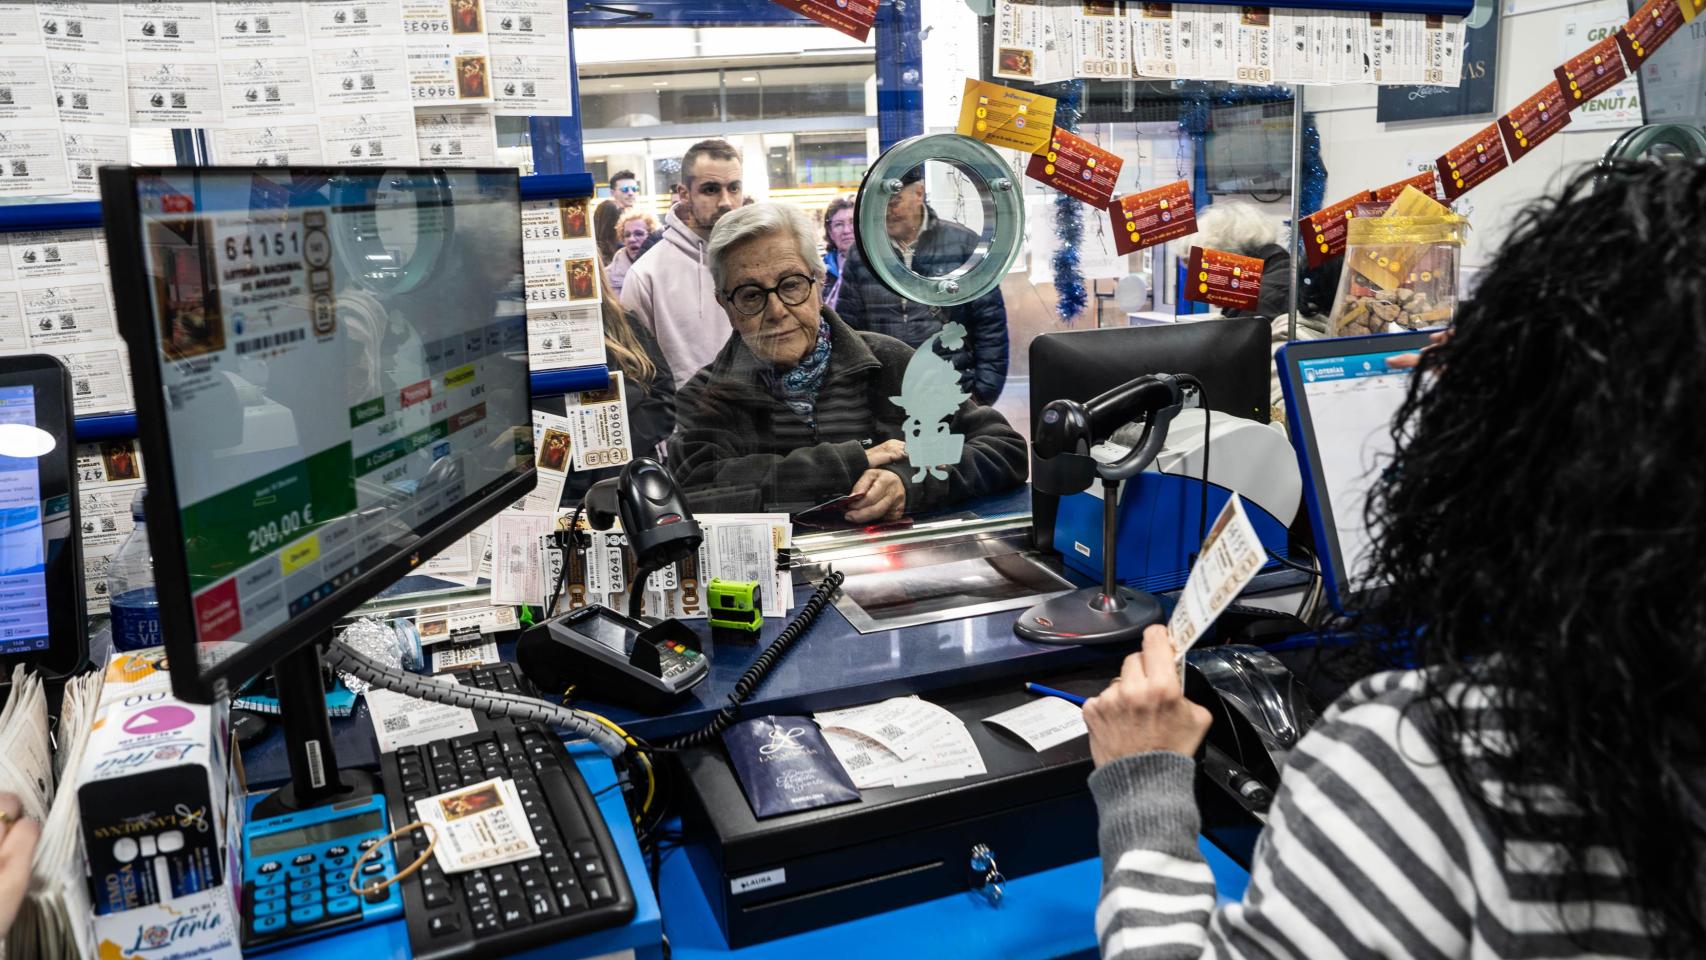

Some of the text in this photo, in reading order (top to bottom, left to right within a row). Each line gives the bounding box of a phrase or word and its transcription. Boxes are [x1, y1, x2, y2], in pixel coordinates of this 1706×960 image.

[404, 21, 449, 32] 9463
[411, 86, 455, 98] 9463
[1628, 96, 1638, 109] A
[225, 230, 299, 262] 64151
[610, 404, 623, 446] 69000
[248, 502, 314, 553] 200,00 €
[611, 549, 622, 590] 24641
[665, 564, 674, 588] 060
[138, 620, 159, 633] FO
[746, 876, 772, 887] LAURA
